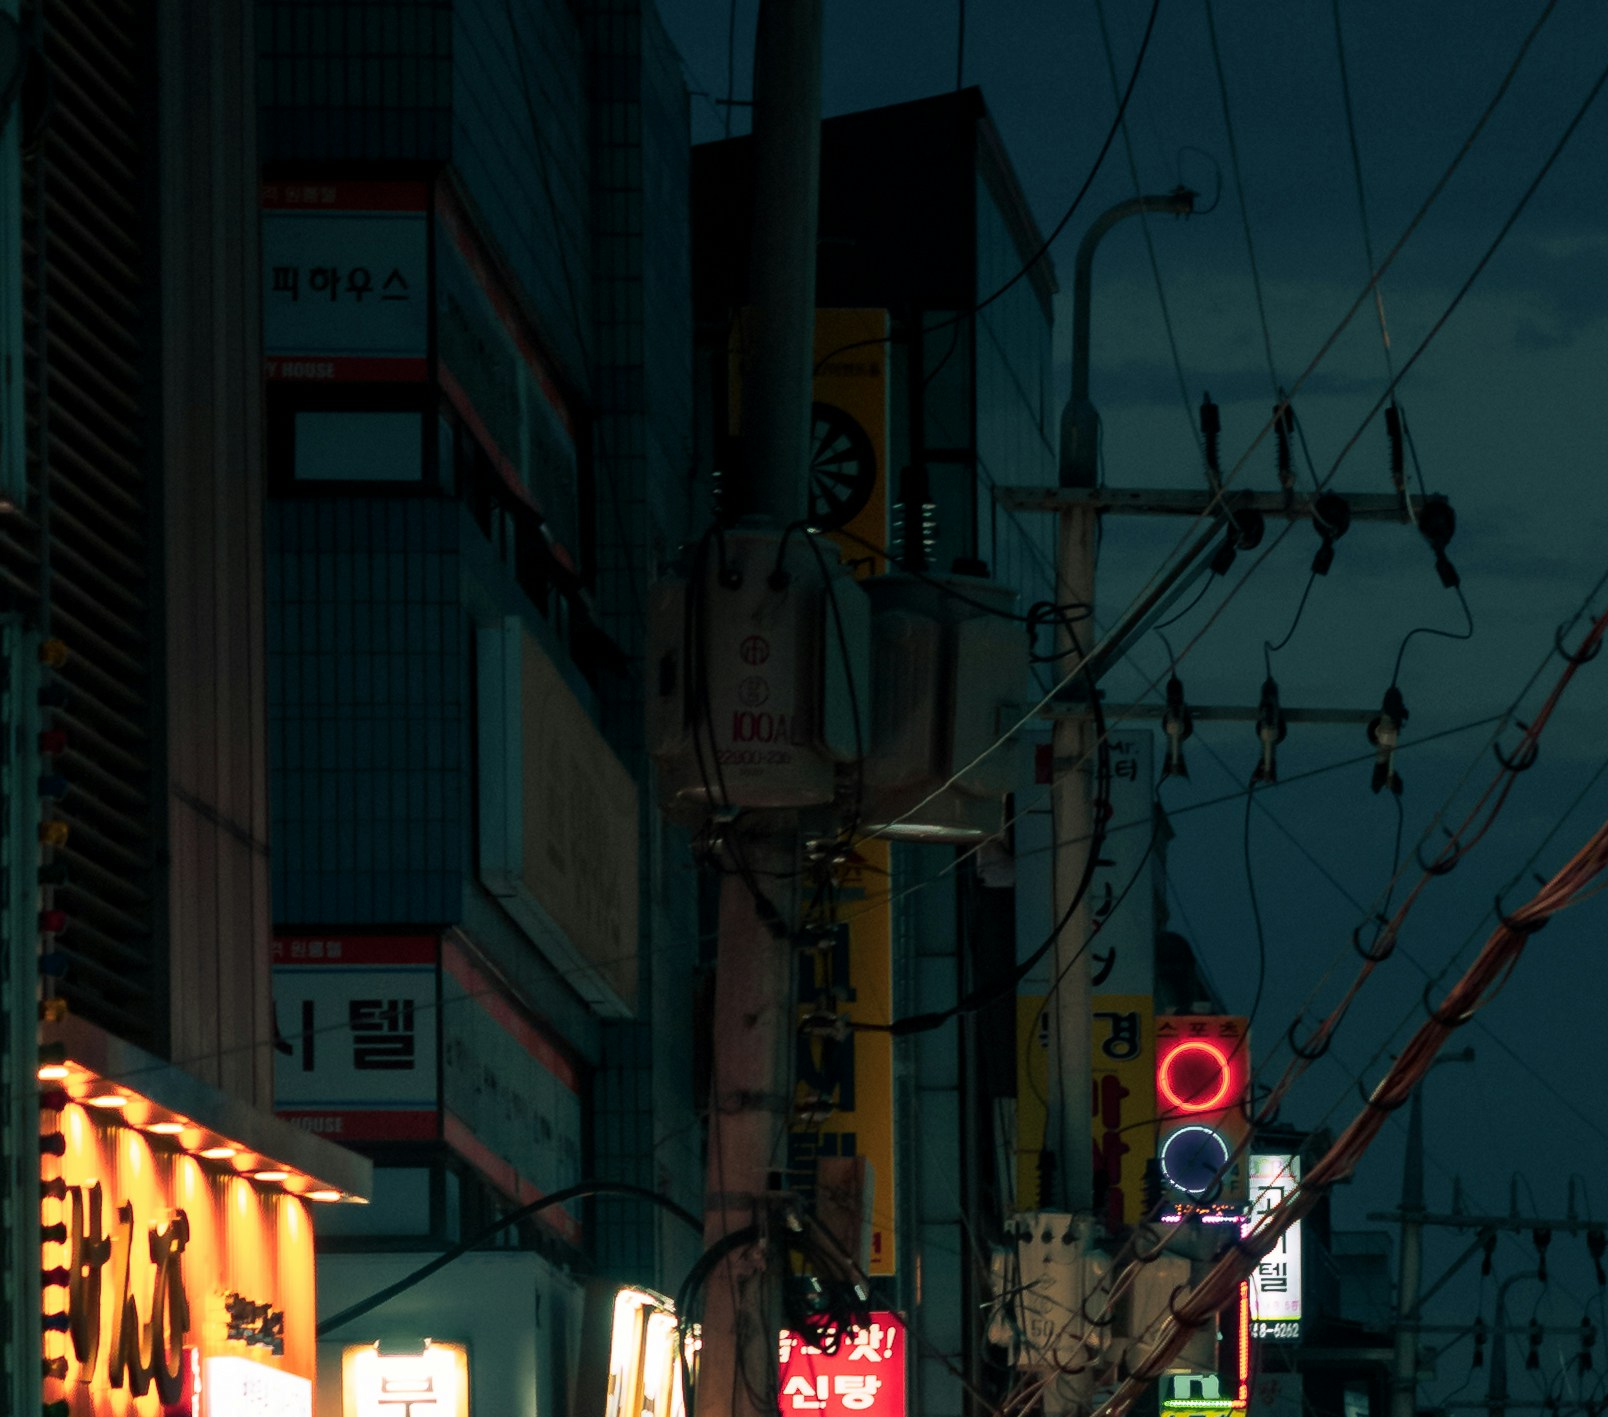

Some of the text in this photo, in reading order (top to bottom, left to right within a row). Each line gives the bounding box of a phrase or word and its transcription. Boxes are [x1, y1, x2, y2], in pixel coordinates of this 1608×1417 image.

[272, 266, 409, 302] 피하우스
[1157, 1021, 1240, 1038] 스포츠
[783, 1375, 883, 1410] 신탕
